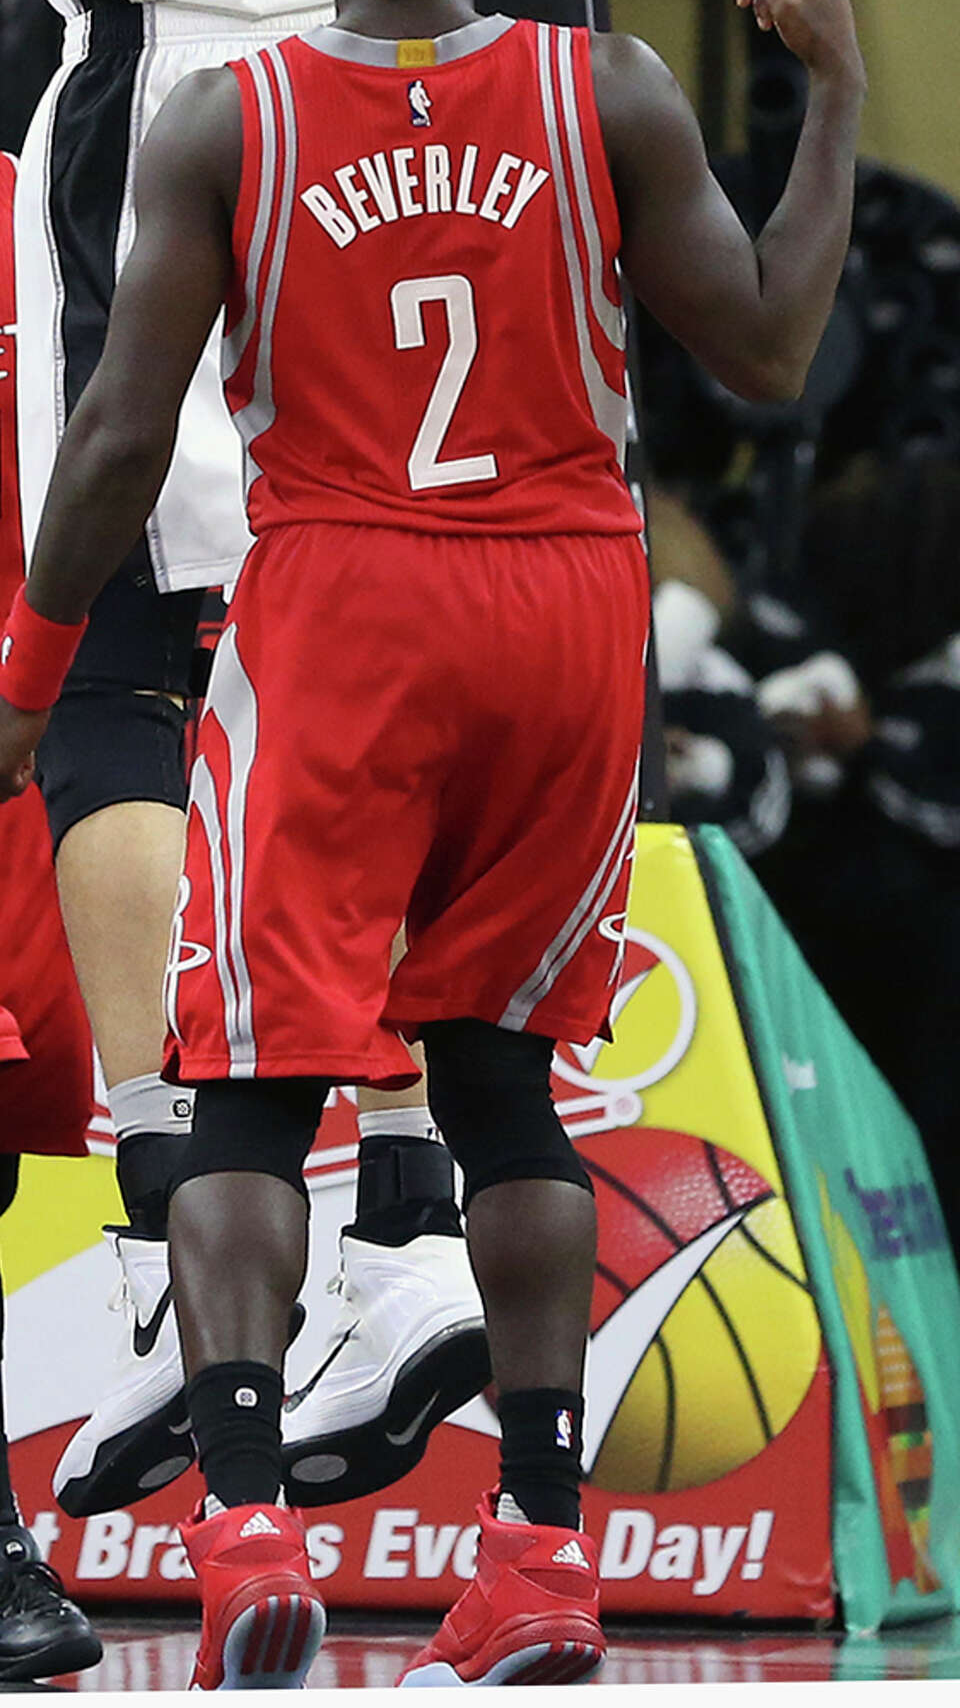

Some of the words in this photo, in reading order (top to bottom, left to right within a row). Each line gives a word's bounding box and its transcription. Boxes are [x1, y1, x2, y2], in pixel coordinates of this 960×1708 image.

[299, 144, 550, 250] BEVERLEY
[390, 274, 499, 491] 2
[75, 1509, 344, 1581] Bras
[363, 1507, 482, 1581] Eve
[598, 1509, 774, 1596] Day!
